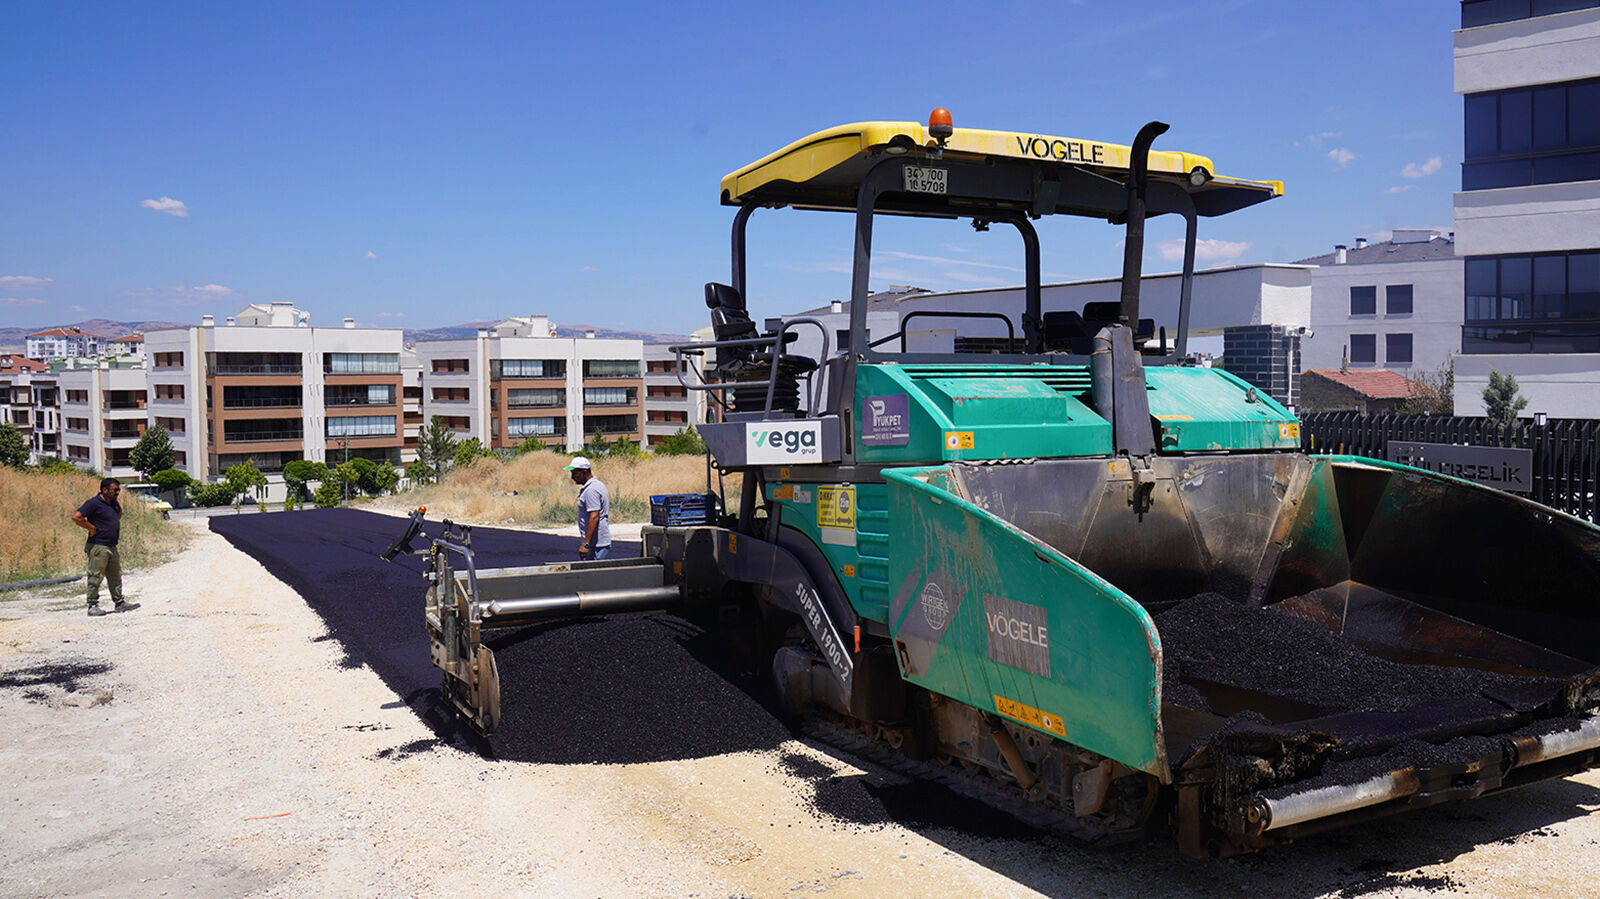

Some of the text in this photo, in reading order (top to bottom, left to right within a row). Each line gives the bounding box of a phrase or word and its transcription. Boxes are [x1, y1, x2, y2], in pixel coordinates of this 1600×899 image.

[1016, 134, 1104, 164] VÖGELE
[921, 180, 945, 193] 5708
[751, 430, 816, 454] vega
[795, 582, 849, 682] SUPER 1900-2
[985, 611, 1048, 649] VÖGELE
